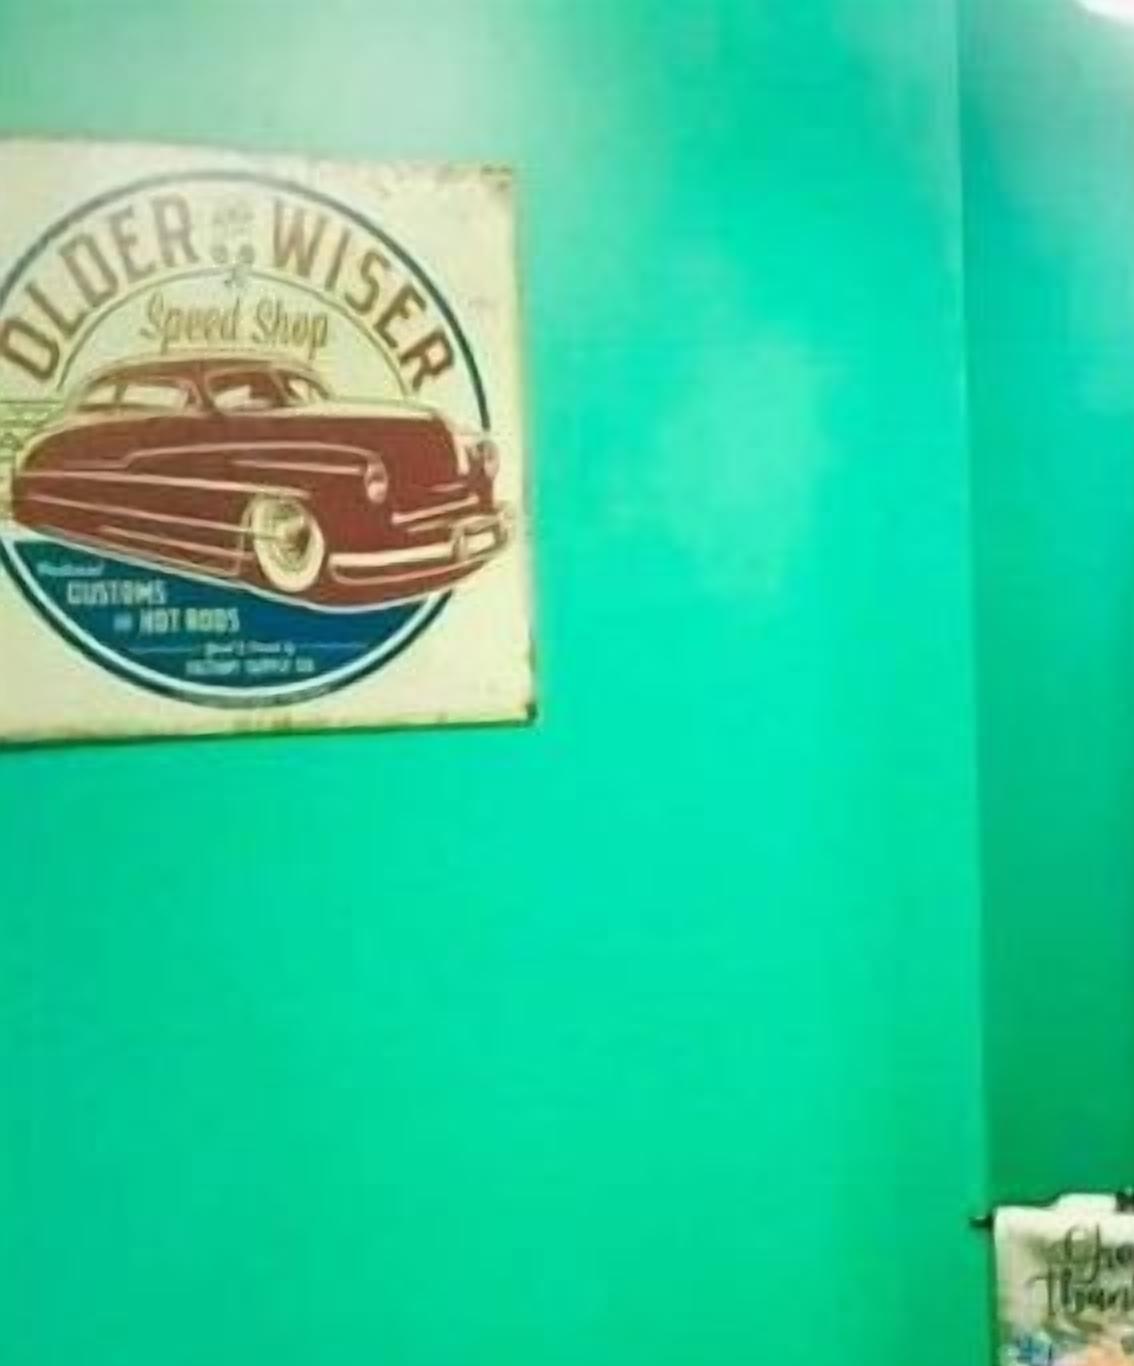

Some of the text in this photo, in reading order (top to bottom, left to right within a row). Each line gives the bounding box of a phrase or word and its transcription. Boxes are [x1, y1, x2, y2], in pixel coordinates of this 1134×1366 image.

[2, 194, 457, 391] OLDER WISER
[139, 291, 329, 360] Speed Shop
[67, 579, 167, 605] CUSTOMS
[139, 608, 180, 635] HOT
[184, 607, 240, 633] RODS
